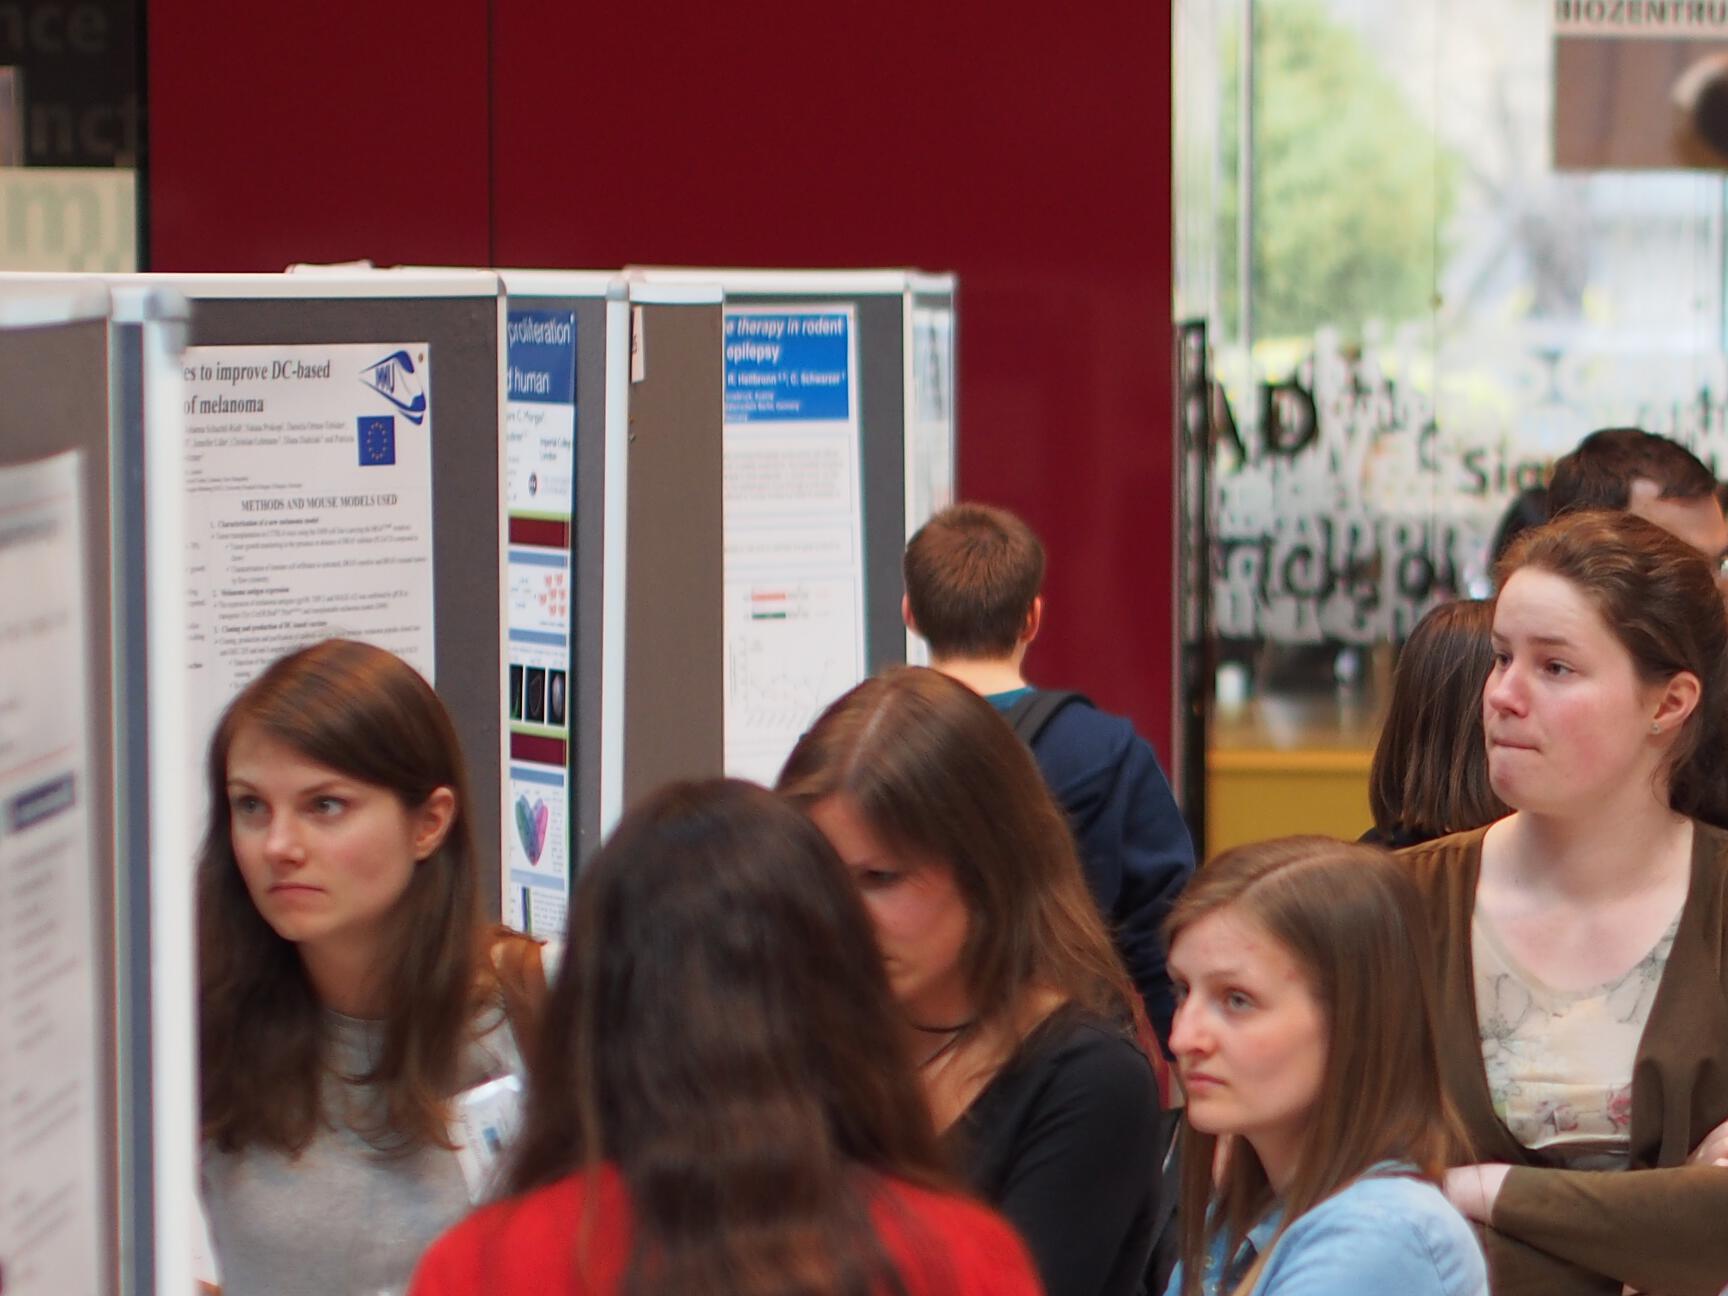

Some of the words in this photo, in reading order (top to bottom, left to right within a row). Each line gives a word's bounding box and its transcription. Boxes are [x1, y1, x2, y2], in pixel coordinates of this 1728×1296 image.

[737, 319, 784, 339] therapy
[788, 319, 799, 335] in
[802, 318, 843, 336] rodent
[727, 342, 779, 365] epilepsy
[201, 363, 212, 381] to
[216, 362, 267, 386] improve
[272, 360, 331, 380] DC-based
[514, 366, 550, 394] human
[200, 394, 264, 415] melanoma
[241, 498, 284, 512] METHODS
[288, 497, 304, 510] AND
[307, 496, 337, 509] MOUSE
[341, 494, 375, 507] MODELS
[377, 493, 397, 506] USED
